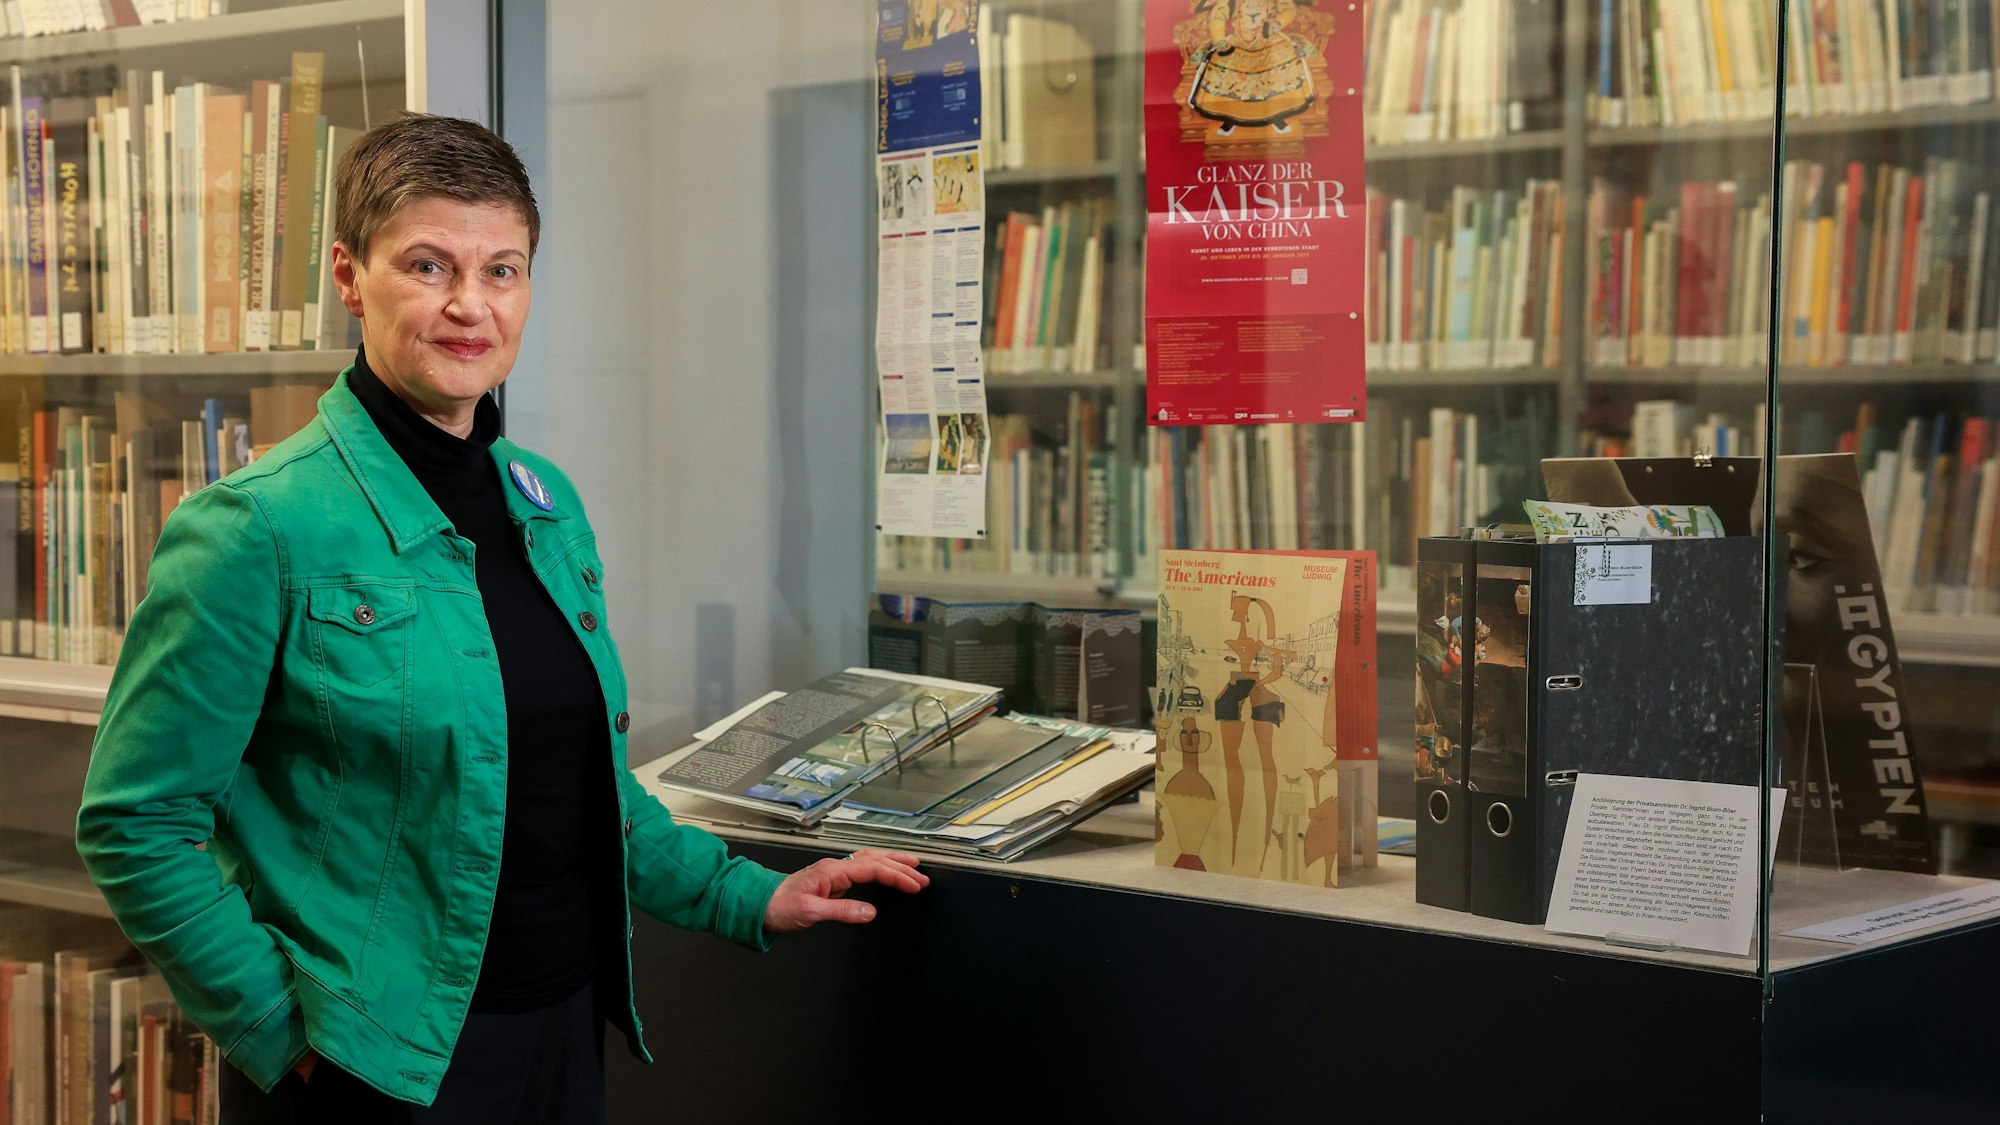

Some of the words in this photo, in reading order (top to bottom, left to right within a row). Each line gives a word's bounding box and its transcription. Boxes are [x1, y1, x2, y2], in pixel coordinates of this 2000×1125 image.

[25, 108, 42, 189] HORNIG
[1197, 164, 1266, 184] GLANZ
[1272, 162, 1313, 181] DER
[253, 152, 266, 235] MÉMOIRES
[1162, 180, 1350, 225] KAISER
[29, 193, 45, 265] SABINE
[1201, 223, 1243, 241] VON
[1248, 221, 1312, 240] CHINA
[251, 237, 265, 287] HORTA
[1165, 558, 1183, 568] Saul
[1183, 559, 1222, 569] Steinberg
[1303, 564, 1338, 574] MUSEUM
[1354, 558, 1363, 580] The
[1165, 567, 1192, 583] The
[1192, 569, 1277, 589] Americans
[1302, 572, 1332, 581] LUDWIG
[1354, 584, 1363, 646] Americans
